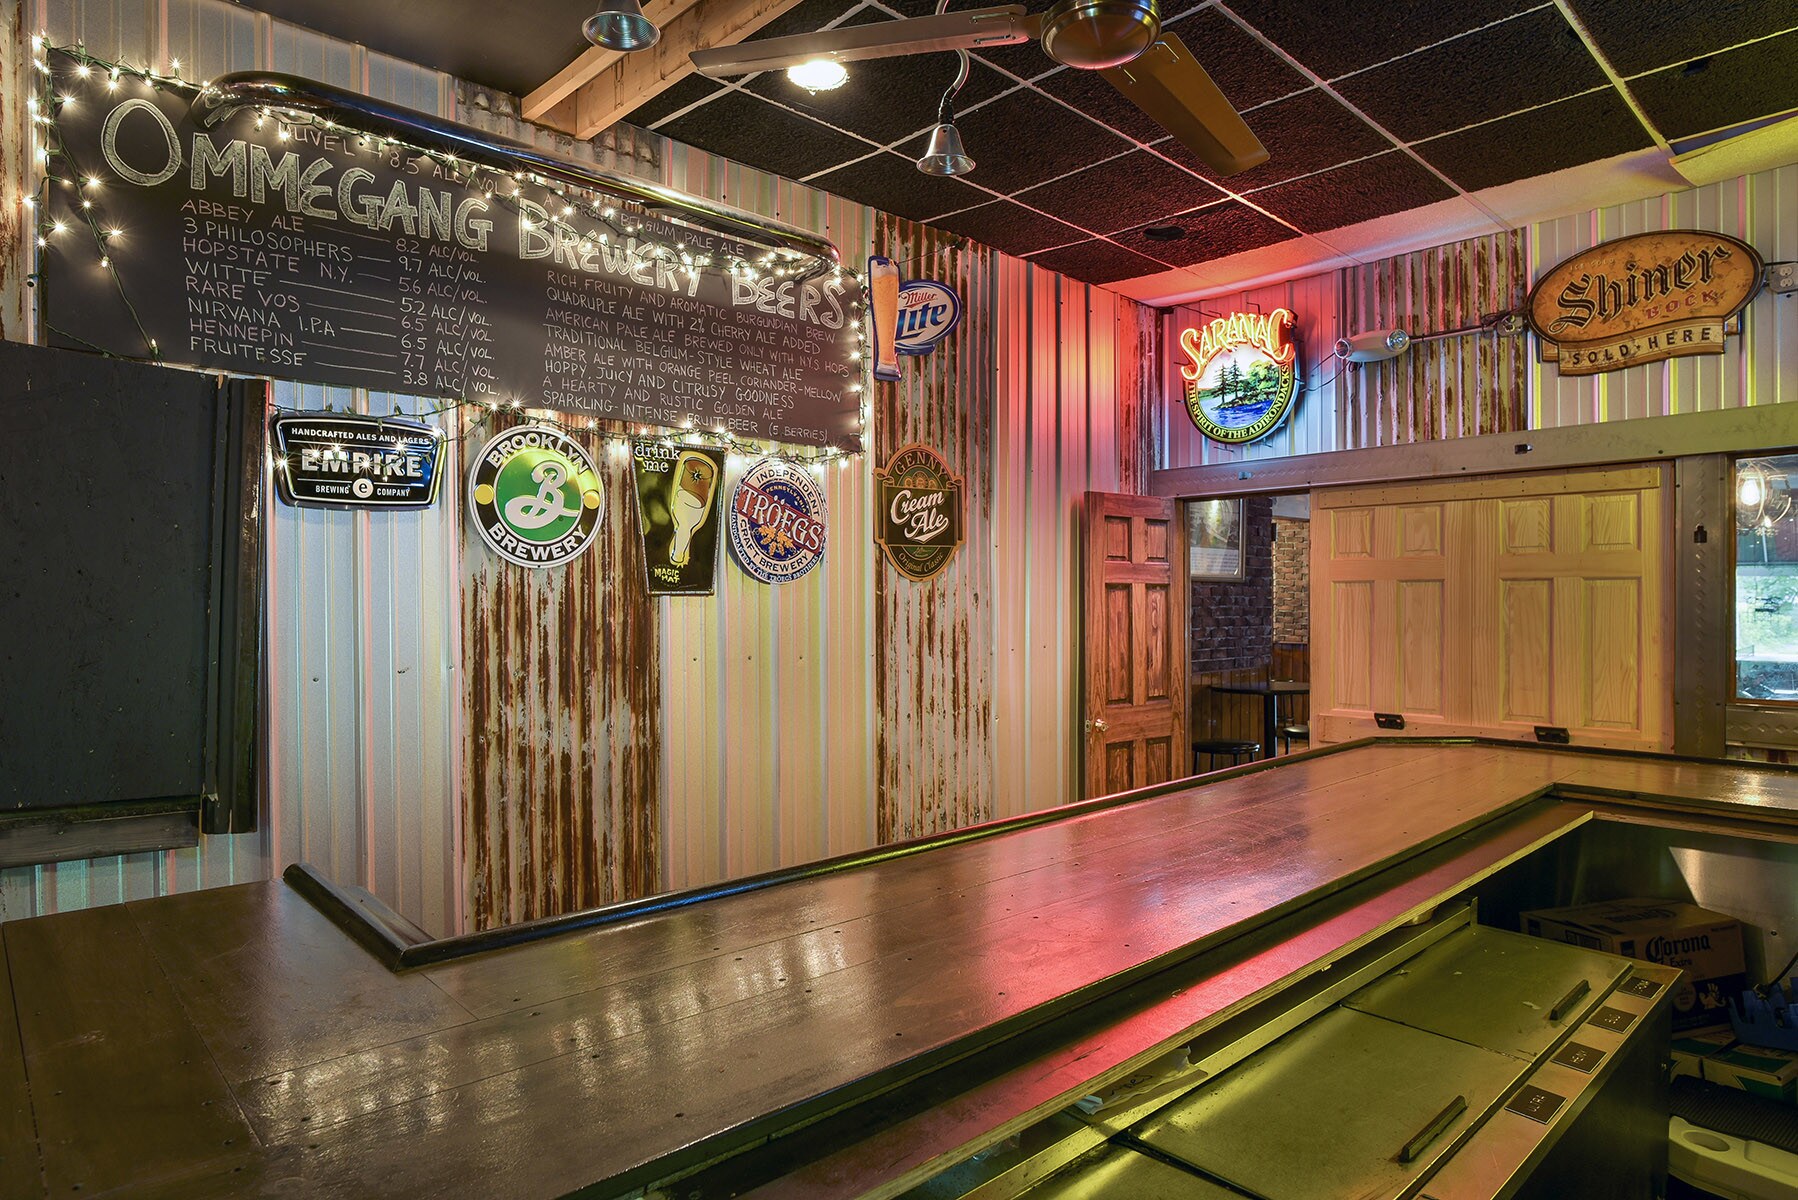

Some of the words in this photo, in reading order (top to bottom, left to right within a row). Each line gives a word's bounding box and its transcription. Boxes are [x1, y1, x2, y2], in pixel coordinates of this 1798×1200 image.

[101, 99, 493, 253] OMMEGANG
[389, 151, 420, 175] 8.5
[180, 200, 254, 223] ABBEY
[271, 215, 305, 232] ALE
[395, 238, 421, 254] 8.2
[543, 193, 554, 207] A
[684, 231, 714, 249] PALE
[720, 242, 745, 256] ALE
[183, 217, 198, 234] 3
[205, 220, 353, 262] PHILOSOPHERS
[398, 255, 423, 273] 9.7
[428, 262, 487, 284] ALC/VOL.
[183, 237, 300, 272] HOPSTATE
[320, 262, 353, 284] N.Y.
[398, 277, 422, 294] 5.6
[427, 282, 488, 303] ALC/VOL.
[185, 257, 272, 286] WITTE
[400, 297, 427, 316] 5.2
[431, 304, 493, 326] ALC/VOL.
[185, 275, 246, 301] RARE
[257, 290, 301, 313] VOS
[401, 315, 428, 332] 6.5
[435, 322, 495, 342] ALC/VOL.
[900, 291, 937, 306] Miller
[1548, 243, 1733, 335] Shiner
[1645, 289, 1718, 320] BOCK
[188, 297, 281, 328] NIRVANA
[401, 333, 428, 350] 6.5
[436, 339, 495, 360] ALC/VOL.
[546, 287, 617, 315] QUADRUPLE
[622, 305, 645, 322] ALE
[652, 310, 685, 329] WITH
[689, 316, 705, 334] 2%
[710, 322, 751, 341] CHERRY
[755, 330, 777, 345] ALE
[782, 336, 821, 355] ADDED
[584, 279, 633, 299] FRUITY
[640, 290, 666, 308] AND
[670, 297, 727, 321] AROMATIC
[736, 312, 798, 335] BURGUNDIAN
[805, 326, 836, 344] BREW
[895, 303, 948, 340] Lite
[189, 318, 294, 347] HENNEPIN
[400, 351, 425, 370] 7.7
[190, 336, 308, 366] FRUITESSE
[403, 370, 428, 386] 3.8
[543, 323, 627, 352] TRADITIONAL
[739, 358, 777, 376] WHEAT
[782, 368, 804, 382] ALE
[544, 343, 587, 363] AMBER
[593, 353, 615, 366] ALE
[621, 356, 653, 371] WITH
[659, 361, 702, 379] ORANGE
[545, 307, 609, 334] AMERICAN
[616, 321, 648, 339] PALE
[652, 328, 676, 343] ALE
[684, 334, 734, 353] BREWED
[738, 343, 765, 359] ONLY
[769, 350, 794, 364] WITH
[824, 362, 850, 378] HOPS
[1180, 308, 1295, 380] SARANAC
[1572, 345, 1629, 365] SOLD
[1649, 327, 1712, 350] HERE
[542, 375, 553, 388] A
[561, 377, 617, 398] HEARTY
[624, 387, 650, 401] AND
[660, 392, 704, 411] RUSTIC
[713, 401, 756, 417] GOLDEN
[762, 408, 784, 421] ALE
[596, 366, 633, 384] JUICY
[638, 373, 666, 390] AND
[673, 380, 726, 400] CITRUSY
[735, 388, 795, 409] GOODNESS
[1191, 404, 1215, 432] SPIRIT
[1213, 427, 1227, 438] OF
[1225, 429, 1248, 439] THE
[1249, 364, 1290, 434] ADIRONDACKS
[291, 427, 354, 439] HANDCRAFTED
[355, 432, 377, 442] ALES
[378, 434, 396, 443] AND
[398, 436, 430, 446] LAGERS
[622, 402, 678, 423] INTENSE
[728, 418, 759, 433] BEER
[301, 448, 423, 478] EMPIRE
[486, 432, 589, 475] BROOKLYN
[634, 443, 681, 461] drink
[644, 460, 669, 473] me
[895, 450, 947, 477] GENNY
[315, 484, 350, 495] BREWING
[376, 487, 411, 497] COMPANY
[756, 469, 820, 516] INDEPENDENT
[890, 489, 944, 524] Cream
[488, 522, 587, 561] BREWERY
[740, 519, 760, 559] CRAFT
[759, 552, 808, 572] BREWERY
[904, 508, 949, 542] Ale
[654, 568, 680, 578] MAGIC
[661, 574, 680, 583] HAT
[1645, 934, 1711, 965] Corona
